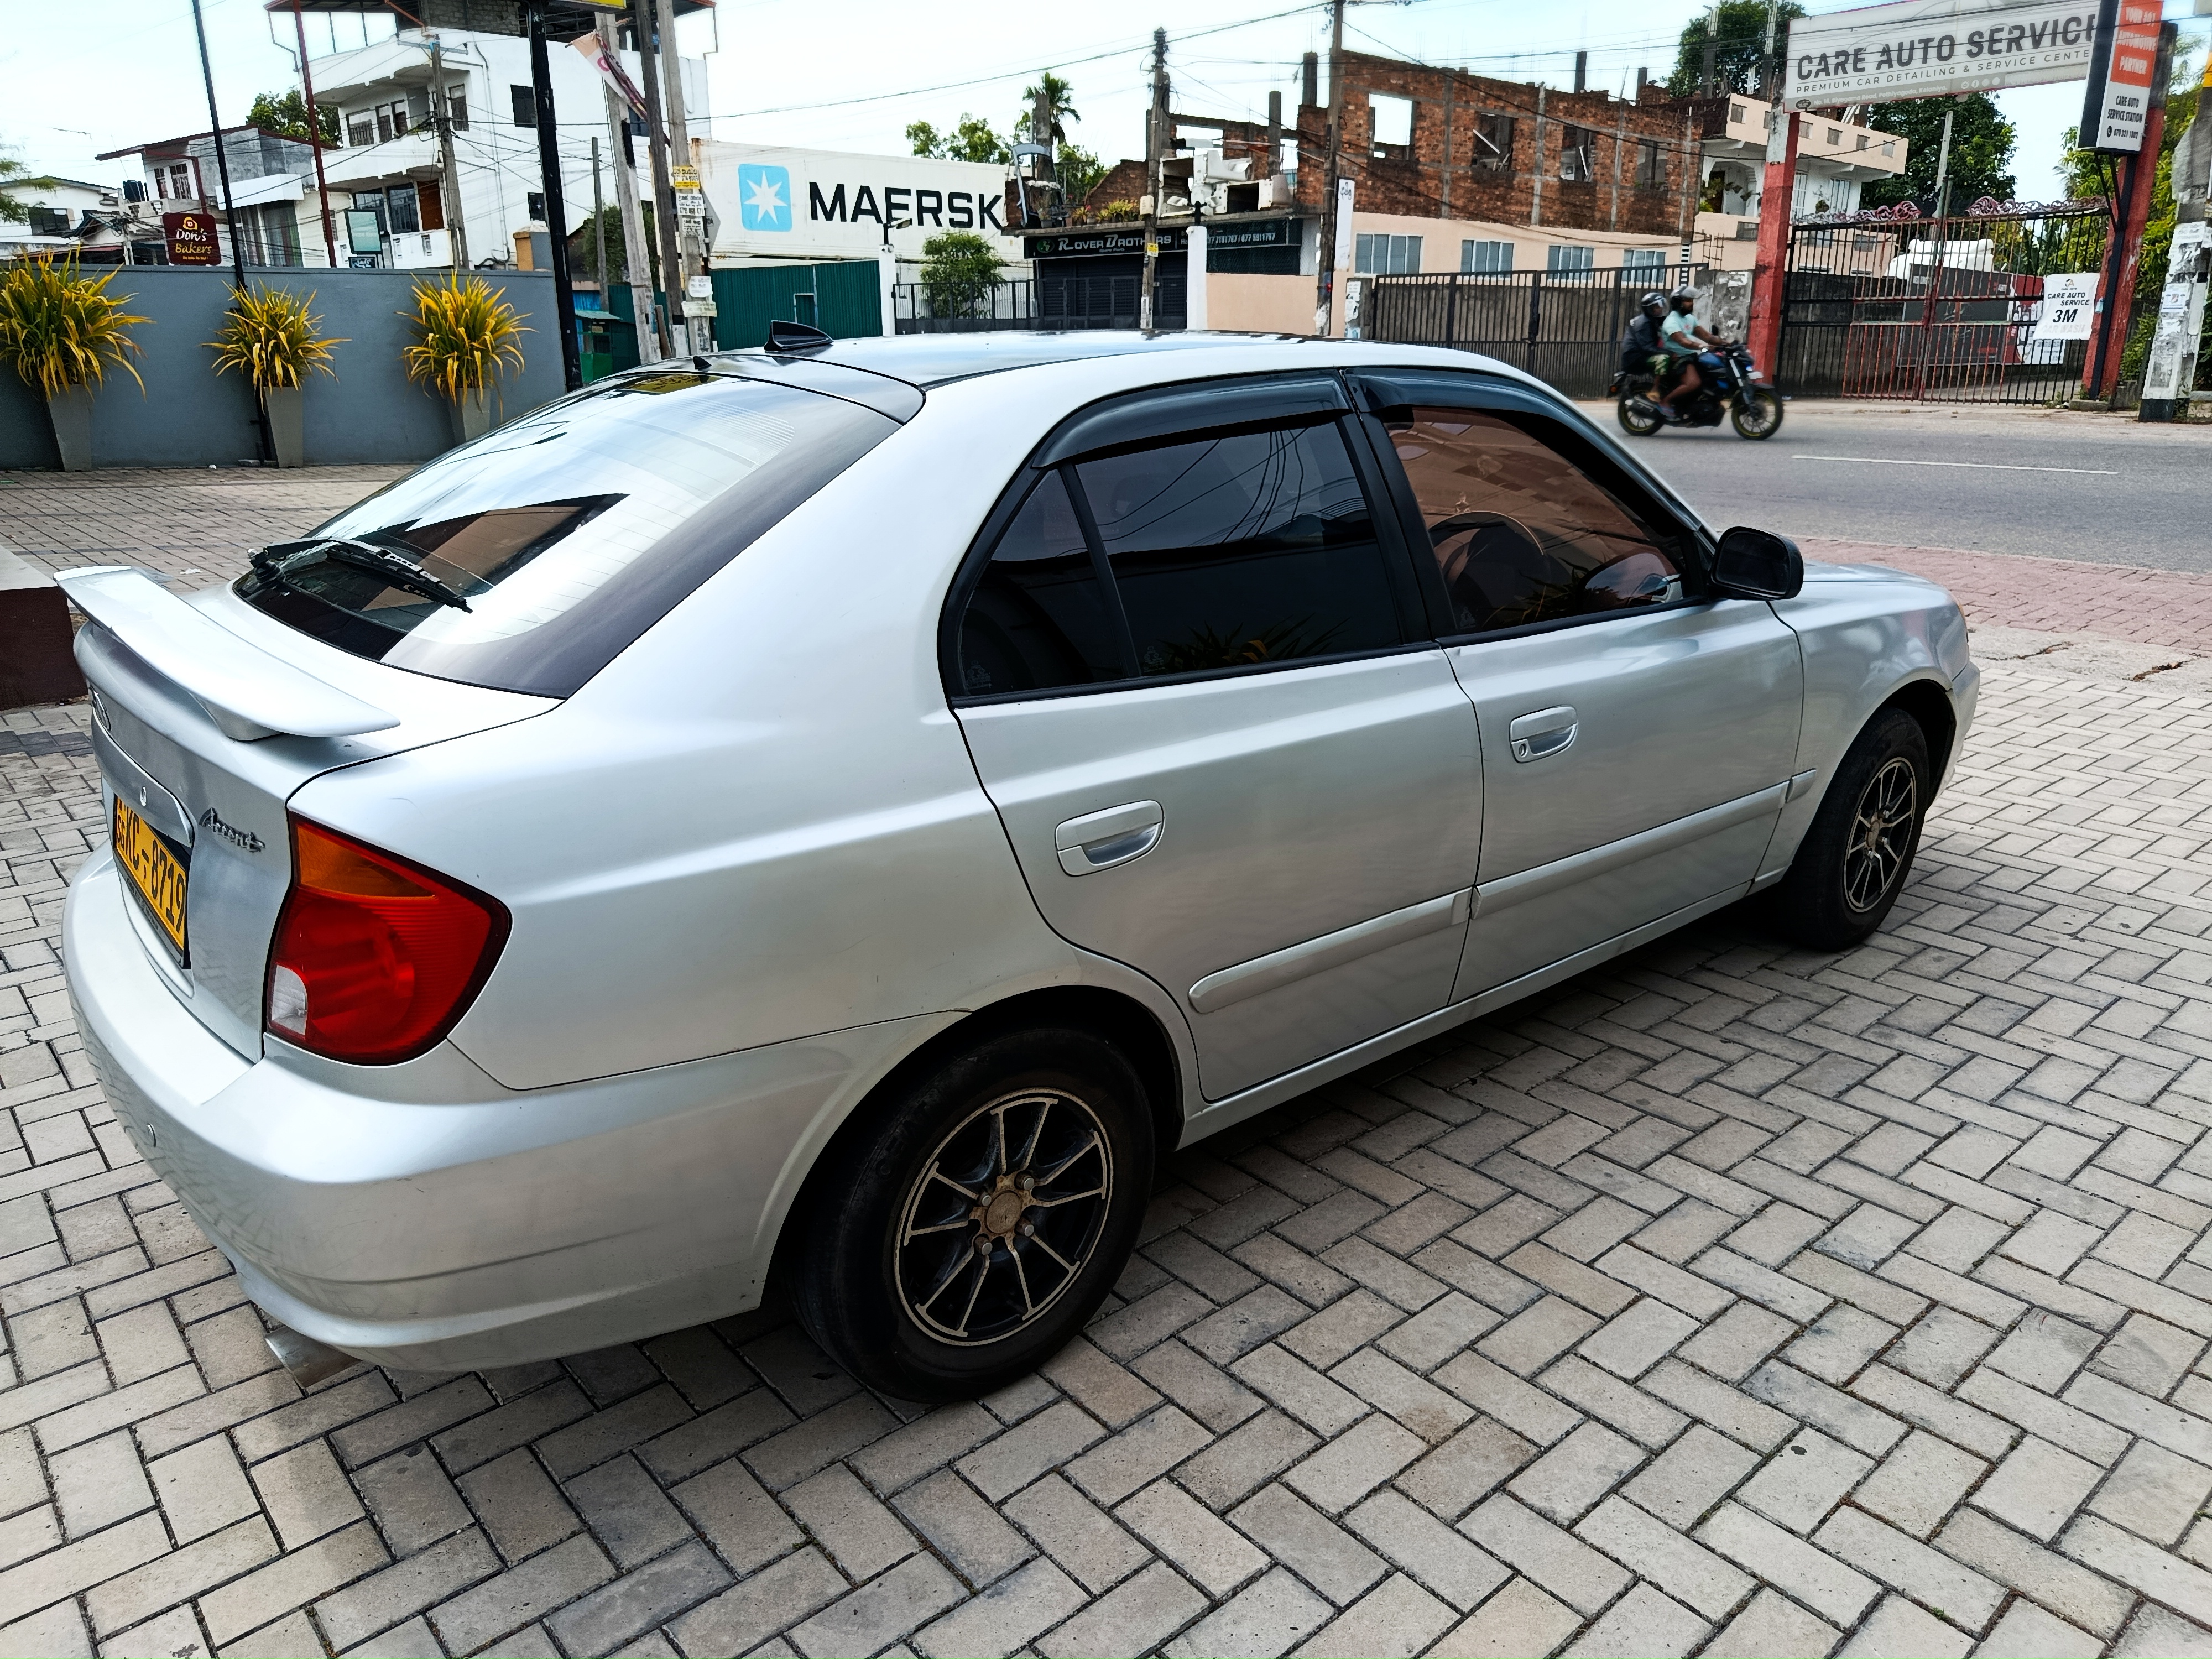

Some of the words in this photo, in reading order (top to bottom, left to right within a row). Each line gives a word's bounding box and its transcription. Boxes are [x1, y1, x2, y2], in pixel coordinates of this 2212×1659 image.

[1797, 47, 1867, 80] CARE
[1876, 35, 1955, 70] AUTO
[1796, 80, 1850, 93] PREMIUM
[1857, 76, 1880, 86] CAR
[1887, 66, 1955, 82] DETAILING
[1978, 56, 2036, 71] SERVICE
[2044, 49, 2089, 62] CENTE
[2116, 95, 2127, 106] CARE
[2127, 97, 2139, 108] AUTO
[2107, 109, 2125, 121] SERVICE
[2125, 112, 2143, 123] STATION
[809, 181, 1003, 230] MAERSK
[175, 228, 207, 241] Don's
[175, 242, 212, 254] Bakers
[1058, 238, 1104, 251] ROVER
[1104, 234, 1172, 248] BROTHRS
[2052, 309, 2078, 323] 3M
